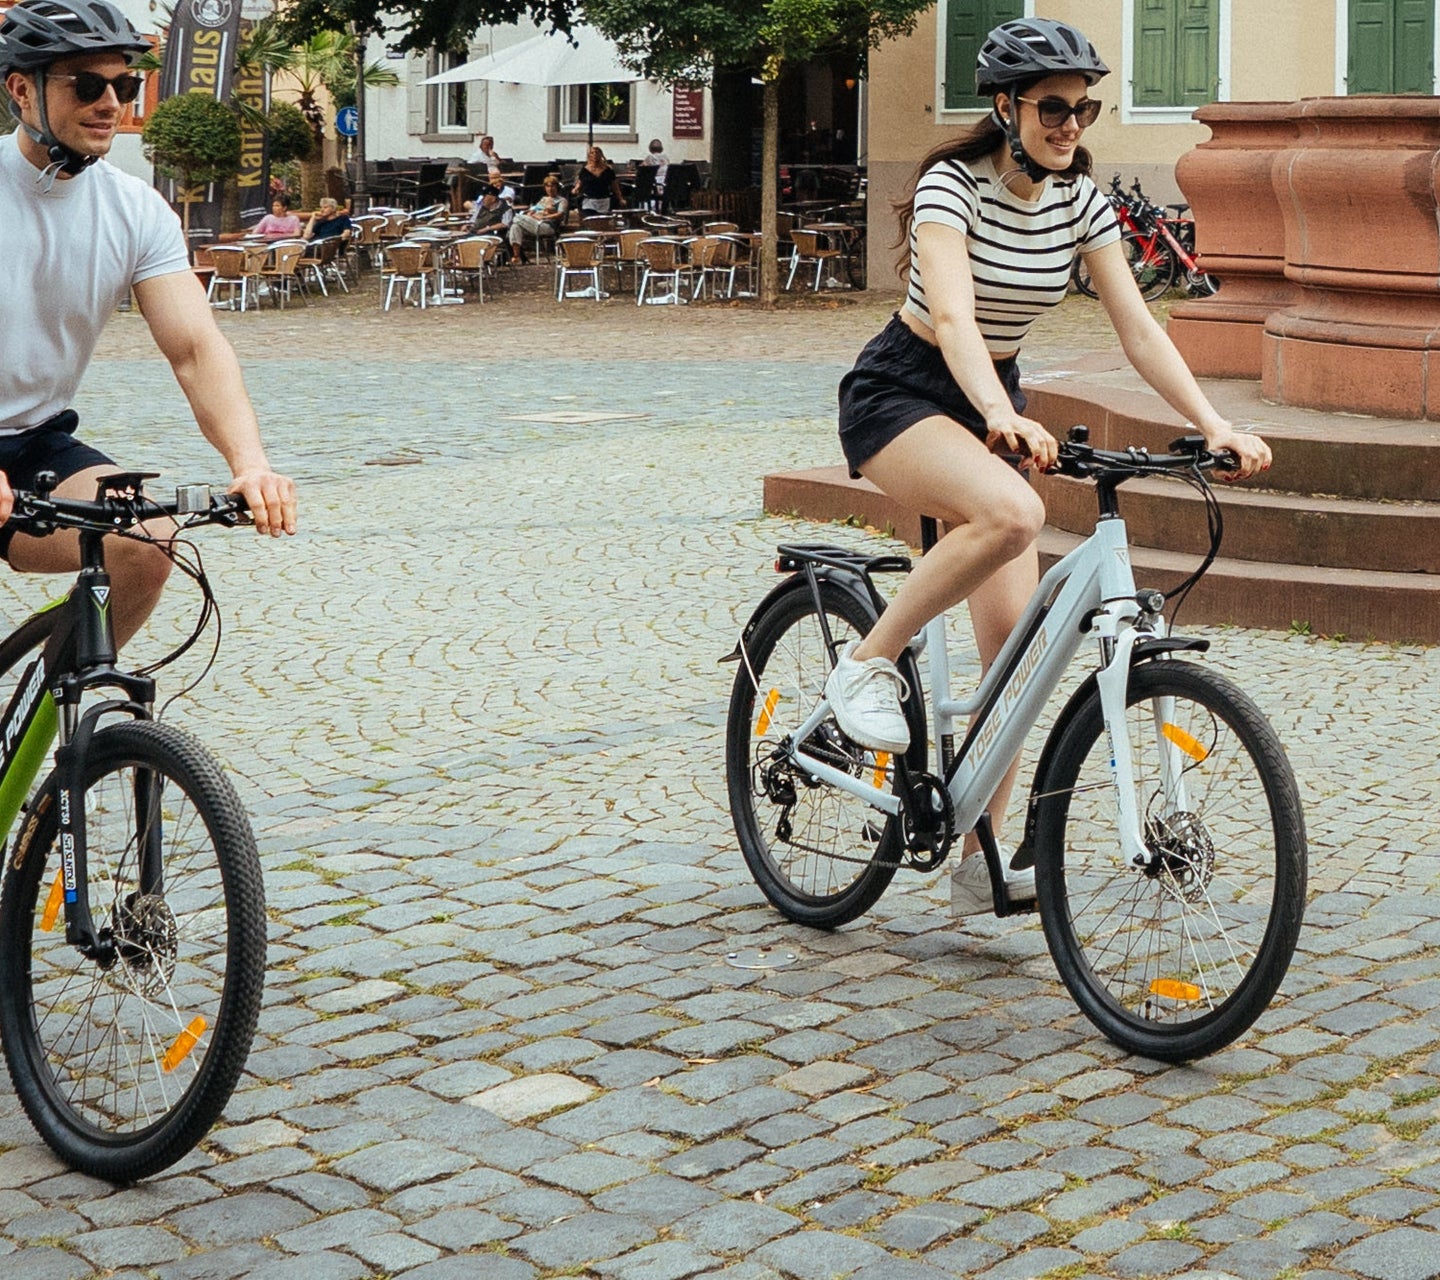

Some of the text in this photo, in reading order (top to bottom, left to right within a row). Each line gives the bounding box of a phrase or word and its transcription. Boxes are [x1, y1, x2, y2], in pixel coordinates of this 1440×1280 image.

[6, 657, 46, 752] POWER
[967, 626, 1048, 771] YOSE POWER
